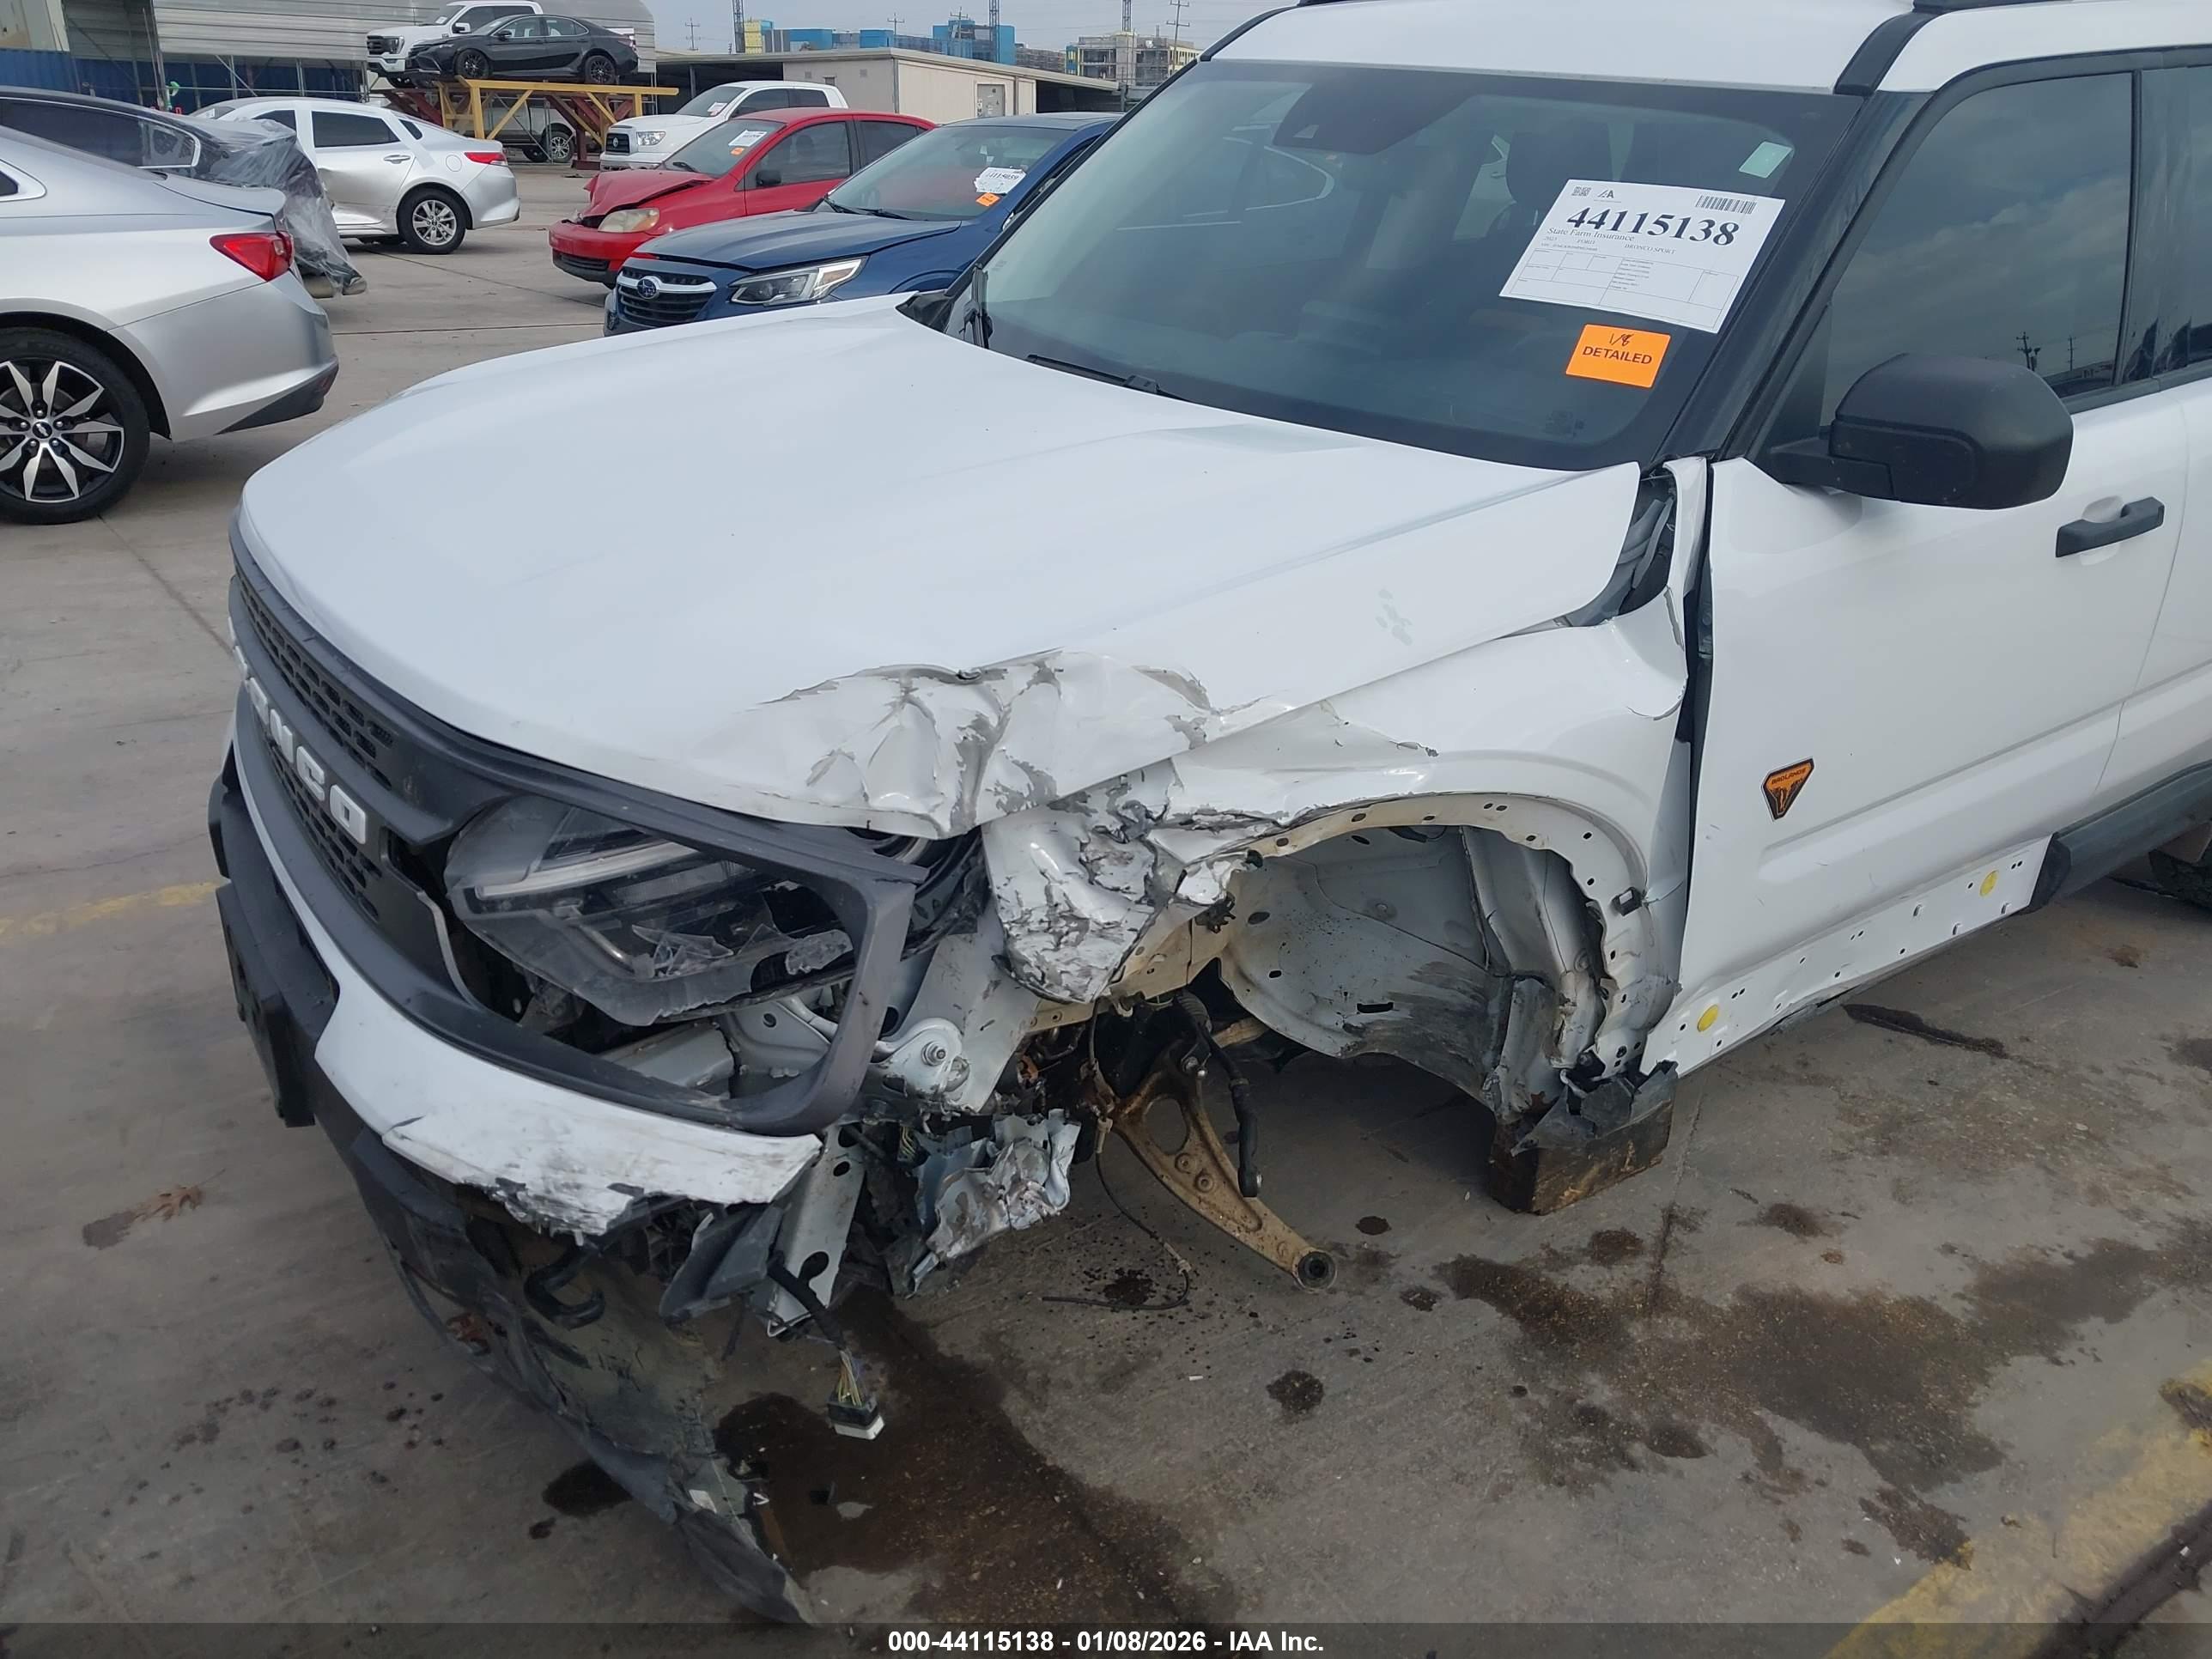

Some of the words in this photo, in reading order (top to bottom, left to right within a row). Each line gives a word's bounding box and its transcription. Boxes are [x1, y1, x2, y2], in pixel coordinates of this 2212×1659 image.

[1547, 227, 1568, 235] State
[1570, 228, 1592, 238] Farm
[1594, 231, 1635, 241] Insurance
[1566, 207, 1740, 246] 44115138
[1583, 346, 1653, 365] DETAILED
